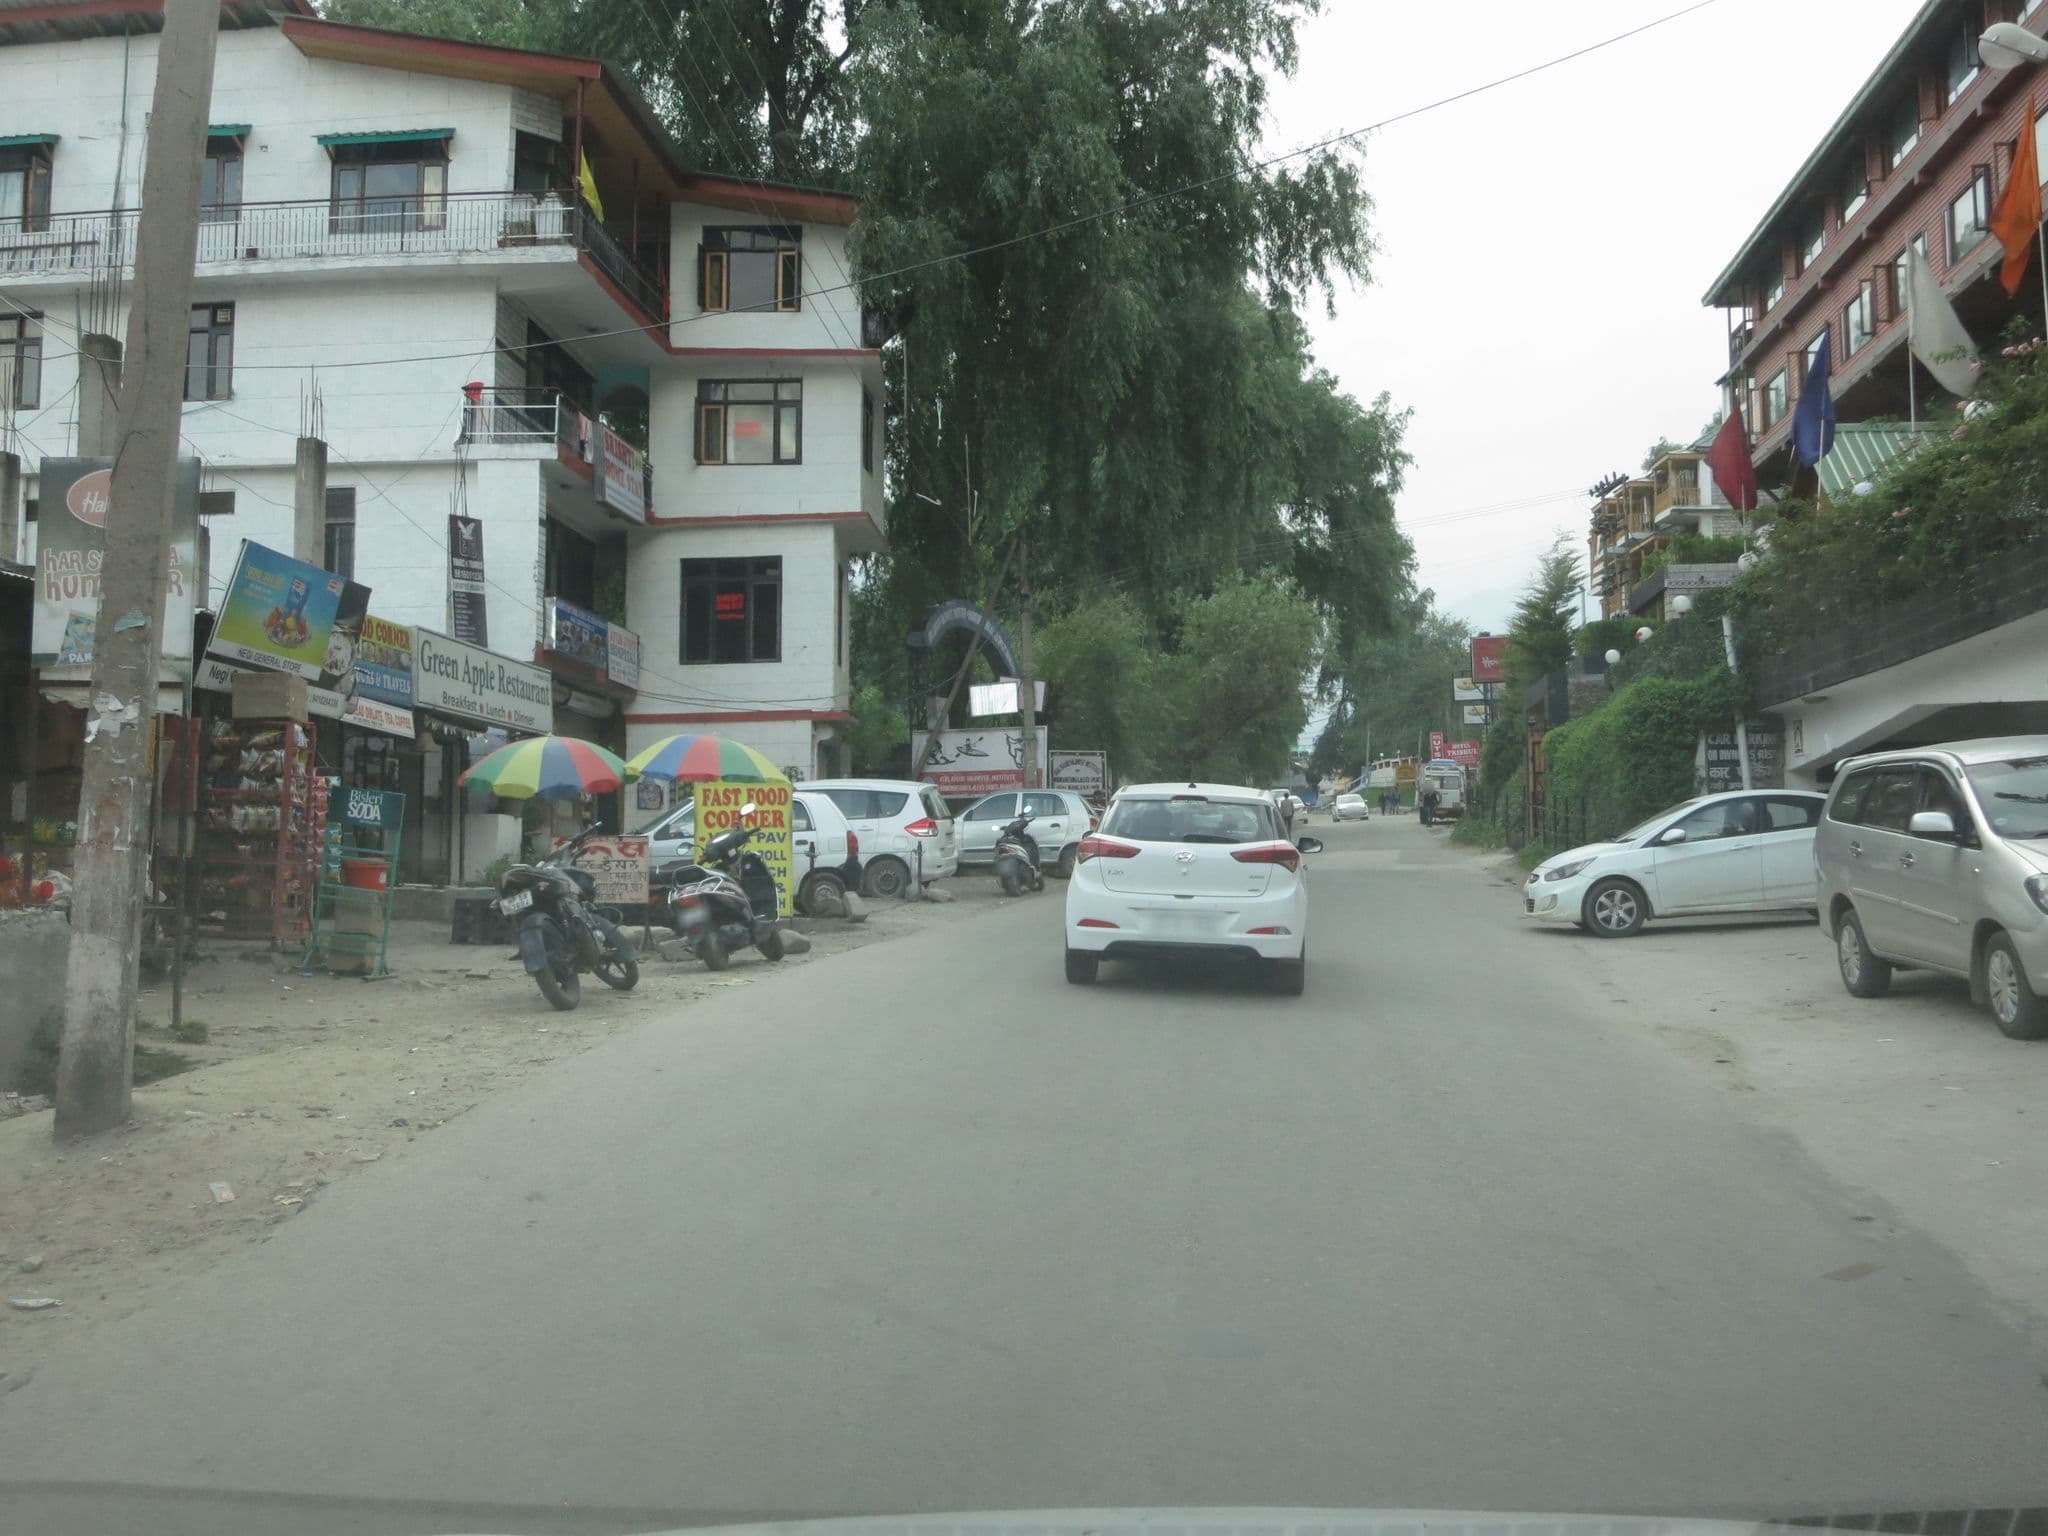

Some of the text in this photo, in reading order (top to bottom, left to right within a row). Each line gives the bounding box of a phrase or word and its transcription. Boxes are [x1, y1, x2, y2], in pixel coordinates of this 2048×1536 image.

[376, 623, 411, 651] CORNER
[238, 648, 302, 673] NEGI GENERAL STORE
[209, 664, 230, 685] Negi
[420, 639, 551, 707] Green Apple Restaurant
[383, 674, 411, 695] TRAVELS
[442, 690, 535, 726] Breakfast Lunch Dinner
[1708, 733, 1730, 745] CAR
[350, 789, 384, 805] Bisleri
[702, 787, 789, 807] FAST FOOD
[347, 801, 382, 821] SODA
[756, 832, 787, 844] PAV
